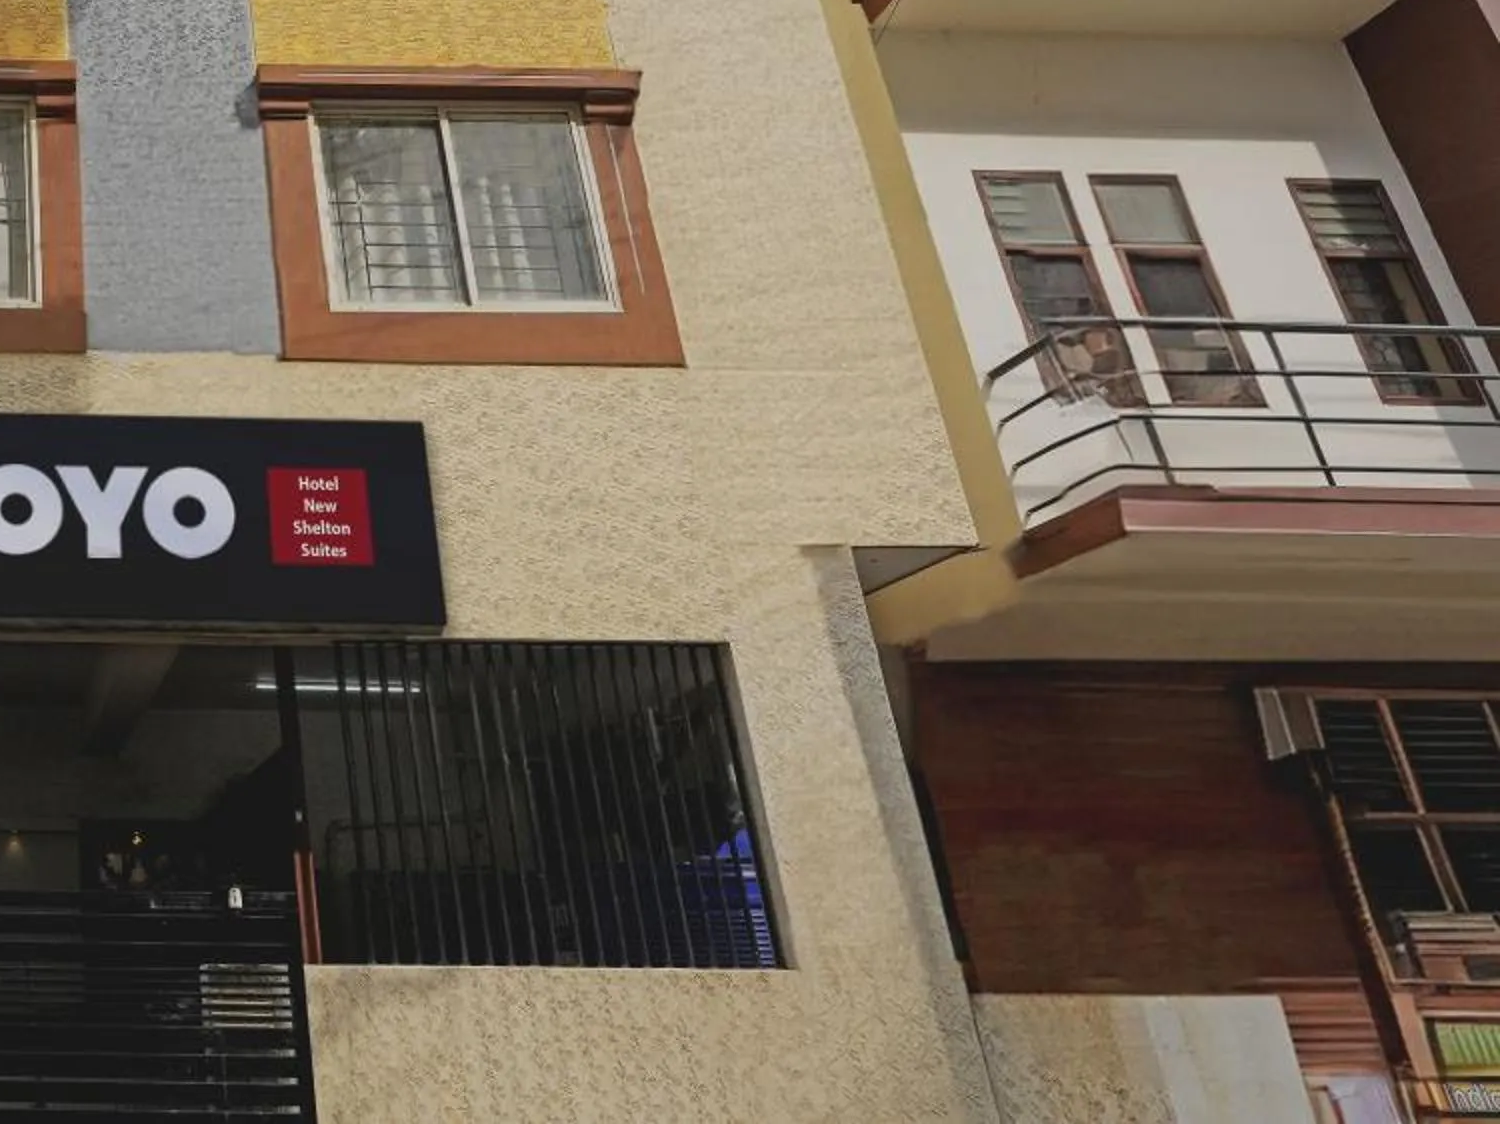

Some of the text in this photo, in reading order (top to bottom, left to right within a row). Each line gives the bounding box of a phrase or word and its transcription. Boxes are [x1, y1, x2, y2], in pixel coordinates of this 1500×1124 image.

[298, 475, 339, 491] Hotel
[303, 497, 337, 513] New
[293, 519, 351, 535] Shelton
[301, 542, 347, 557] Suites
